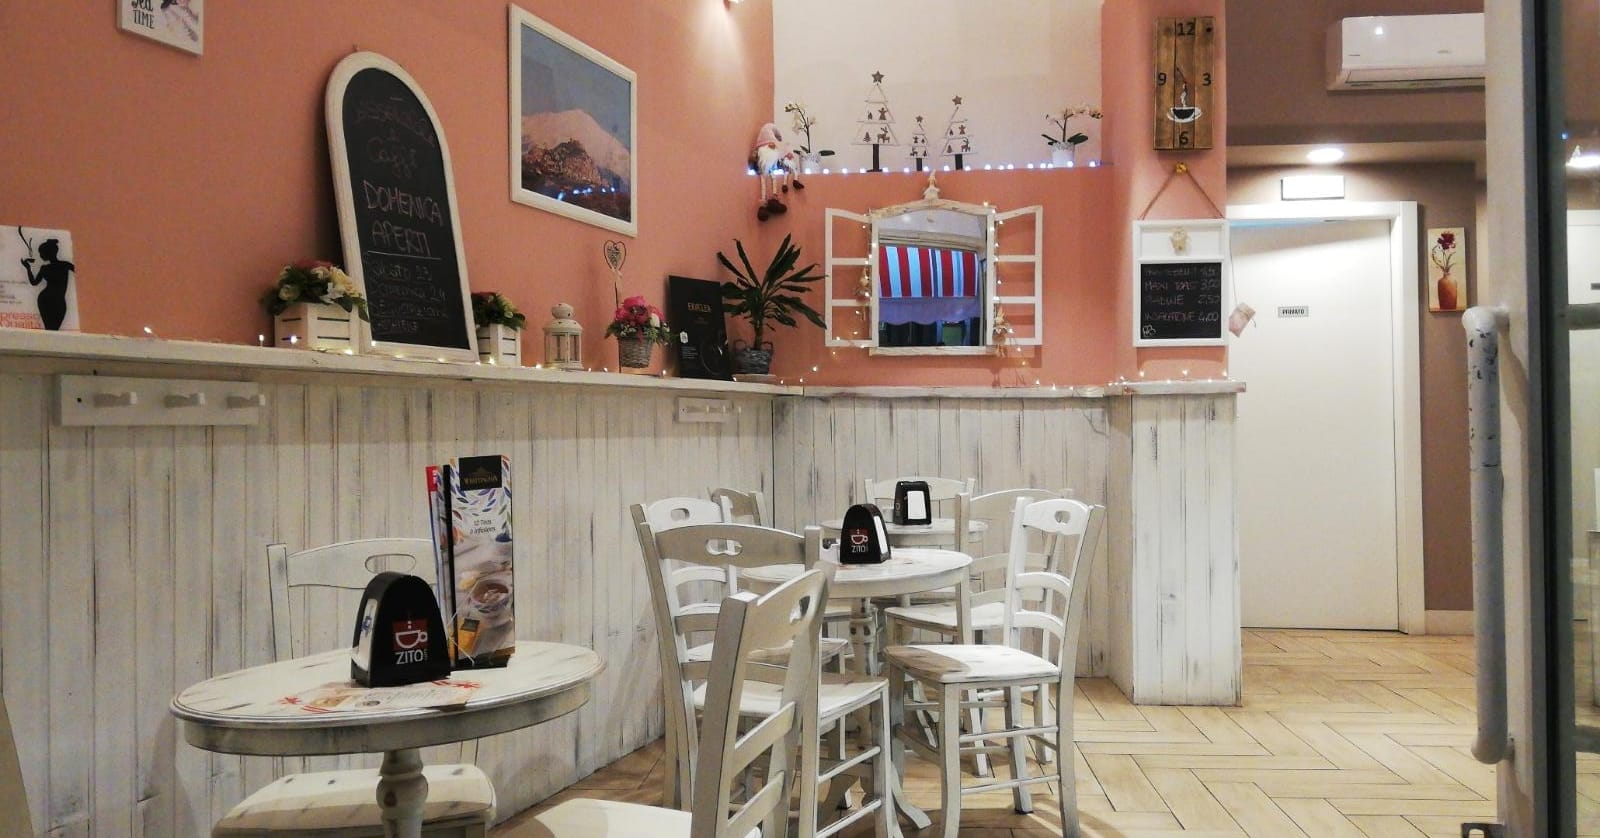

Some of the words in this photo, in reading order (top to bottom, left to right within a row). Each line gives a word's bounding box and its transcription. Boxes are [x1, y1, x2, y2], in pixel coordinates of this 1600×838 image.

[133, 9, 154, 29] TIME
[1177, 22, 1196, 36] 12
[1158, 72, 1167, 86] 9
[1202, 72, 1212, 86] 3
[1179, 131, 1189, 145] 6
[372, 219, 432, 257] APERTI
[851, 545, 866, 553] ZITO
[395, 649, 424, 664] ZITO
